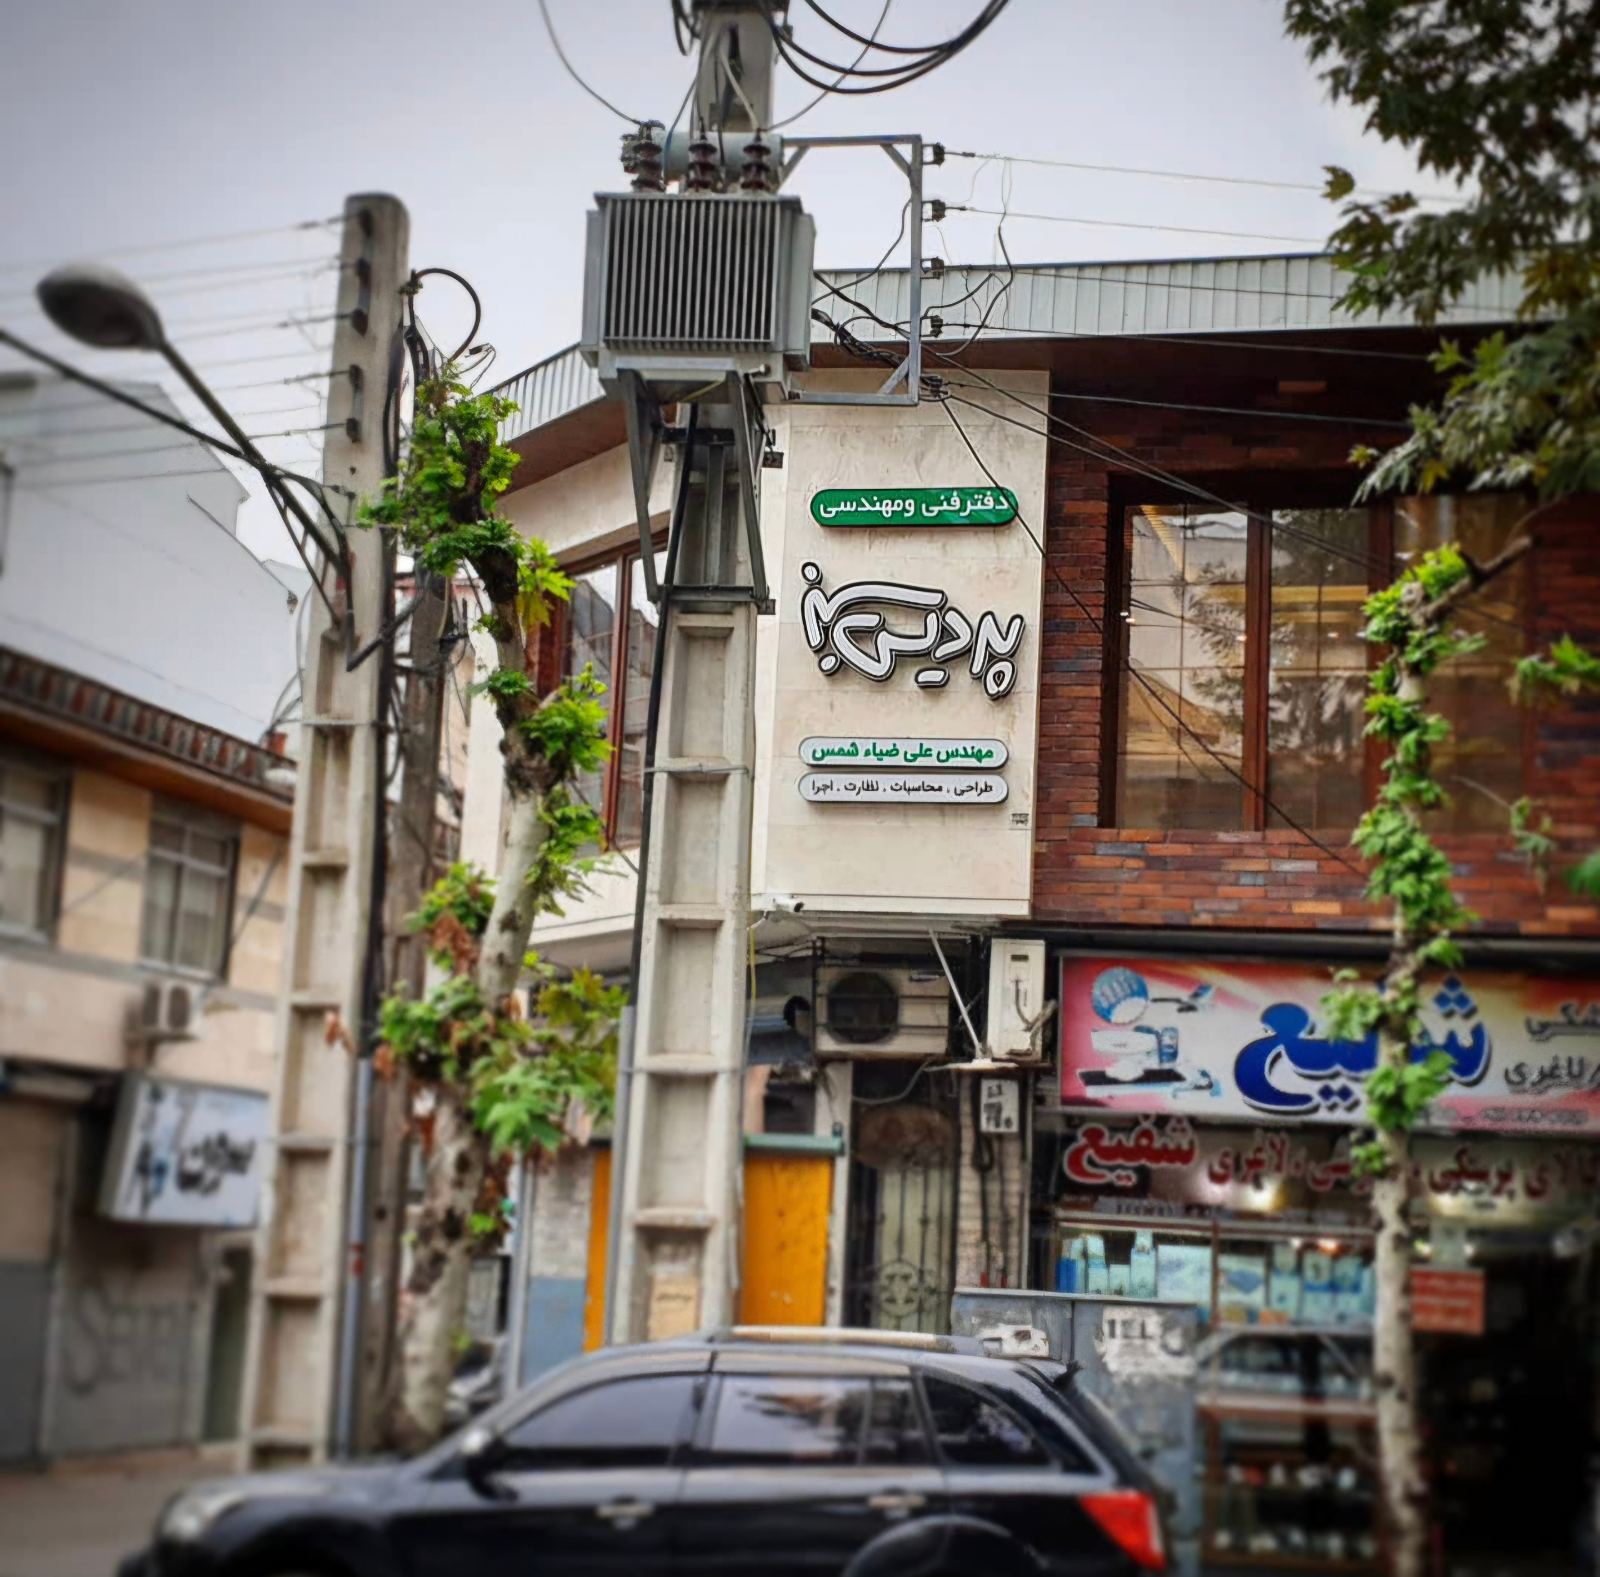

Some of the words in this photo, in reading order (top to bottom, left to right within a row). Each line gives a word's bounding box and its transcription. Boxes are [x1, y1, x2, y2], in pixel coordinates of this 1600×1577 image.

[811, 741, 860, 762] شمس
[863, 741, 900, 762] ضیاء
[903, 742, 933, 763] علی
[936, 745, 995, 765] مهندس
[812, 780, 834, 796] اجرا
[890, 781, 943, 797] محاسبات
[953, 780, 994, 797] طراحی
[1063, 1114, 1199, 1186] شفیع
